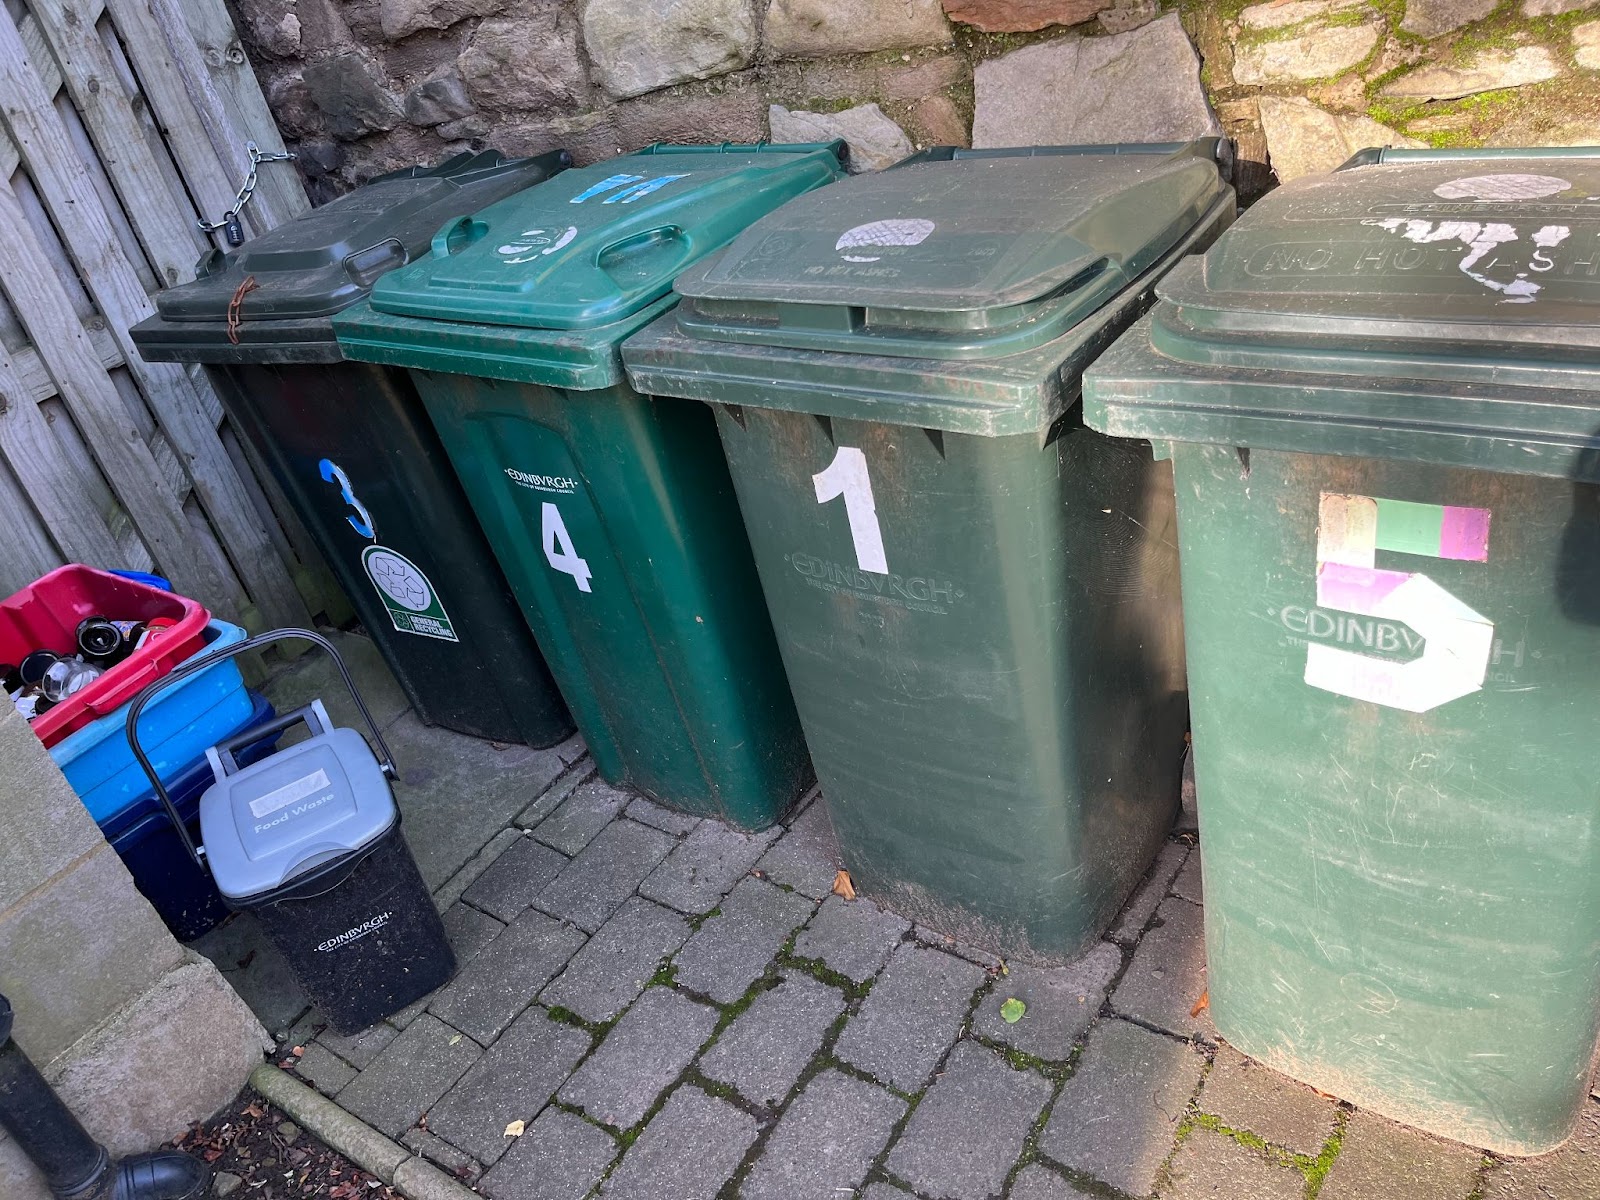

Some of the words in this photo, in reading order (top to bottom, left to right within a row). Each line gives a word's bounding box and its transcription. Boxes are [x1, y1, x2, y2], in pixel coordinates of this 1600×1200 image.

[1265, 248, 1333, 272] NO
[318, 458, 376, 539] 3
[812, 446, 889, 575] 1
[541, 501, 593, 593] 4
[1281, 605, 1526, 668] EDINBVH
[1303, 491, 1496, 714] 5
[254, 812, 290, 834] Food
[291, 793, 335, 816] Waste
